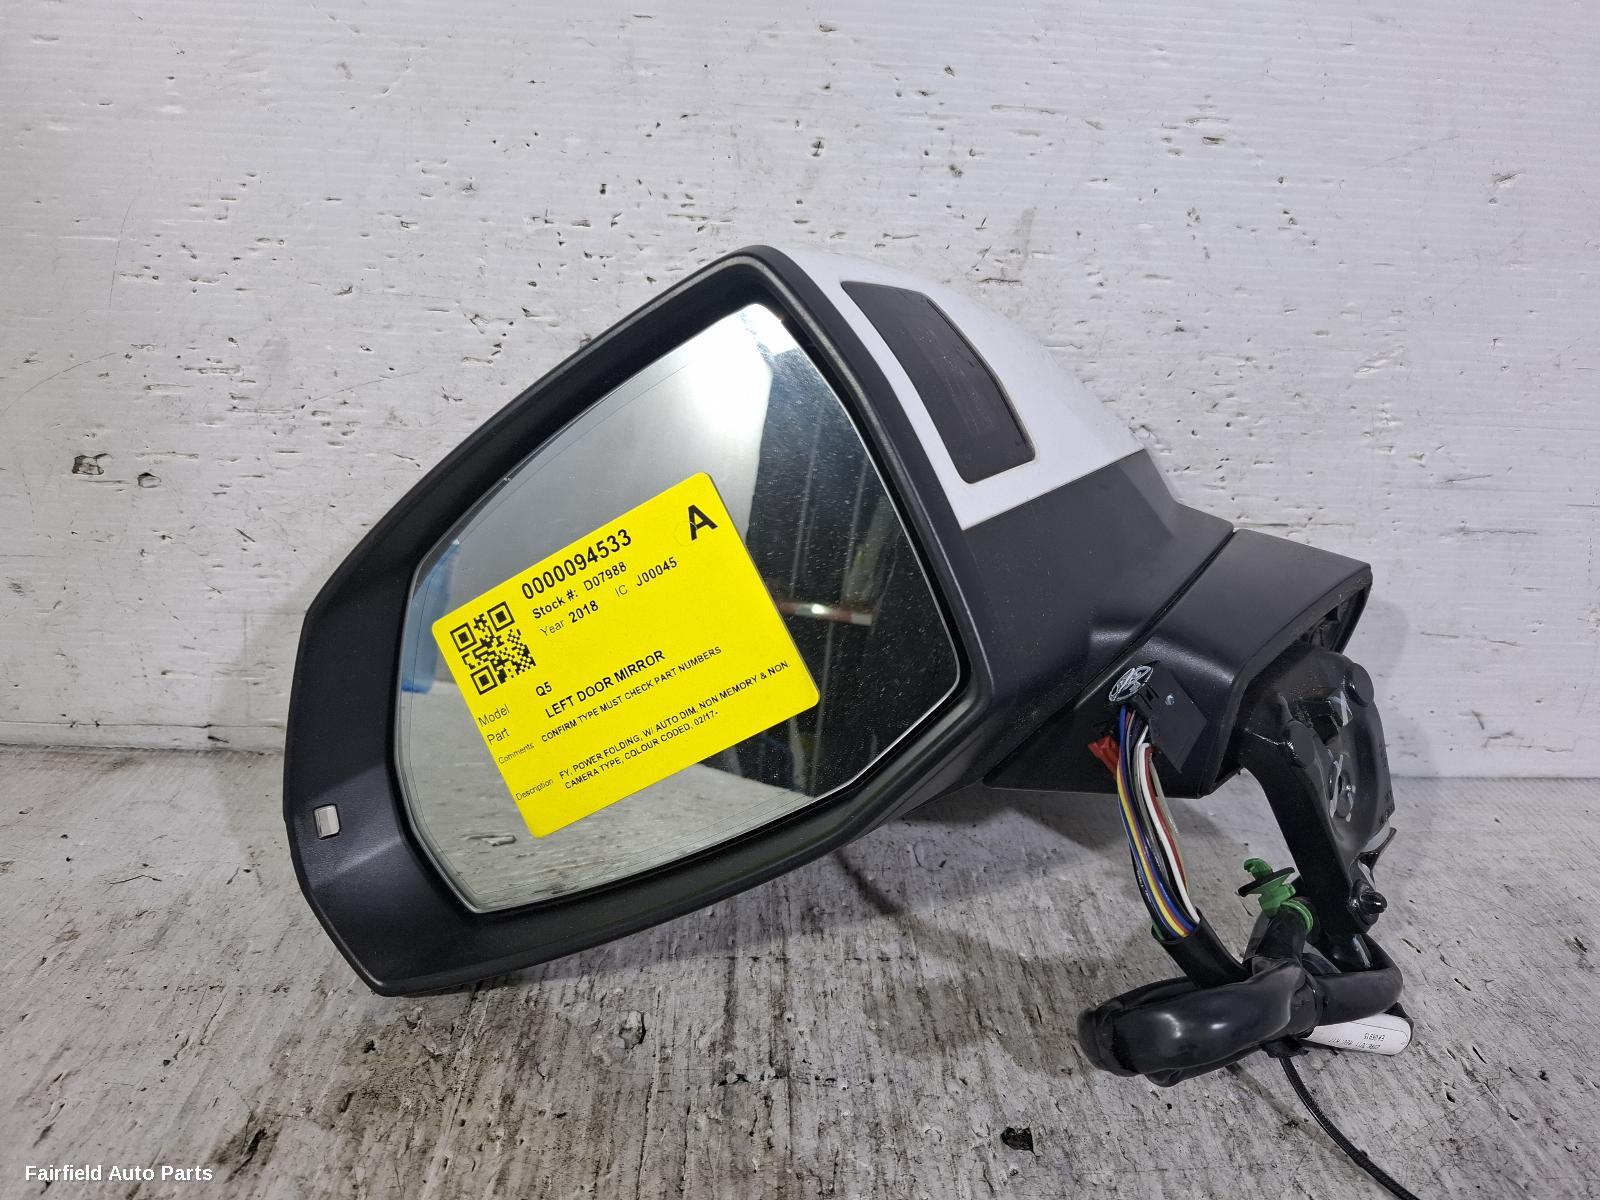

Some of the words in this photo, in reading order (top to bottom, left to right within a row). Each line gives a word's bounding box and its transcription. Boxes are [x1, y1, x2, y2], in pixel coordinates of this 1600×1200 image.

[687, 503, 719, 542] A
[521, 528, 632, 600] 0000094533
[531, 595, 566, 620] Stock
[565, 588, 579, 602] #:
[582, 561, 627, 592] D07988
[614, 584, 628, 598] IC
[636, 556, 678, 587] J00045
[539, 619, 565, 637] Year
[567, 599, 599, 624] 2018
[477, 703, 510, 728] Model
[535, 680, 553, 697] Q5
[486, 727, 510, 746] Part
[544, 694, 575, 719] LEFT
[575, 676, 615, 703] DOOR
[613, 649, 667, 683] MIRROR
[498, 742, 535, 765] Comments
[541, 718, 578, 743] CONFIRM
[576, 707, 600, 724] TYPE
[598, 695, 623, 713] MUST
[624, 679, 655, 700] CHECK
[653, 667, 677, 686] PART
[677, 646, 722, 673] NUMBERS
[515, 778, 554, 801] Description
[572, 752, 605, 773] POWER
[602, 734, 644, 758] FOLDING,
[655, 715, 680, 733] AUTO
[698, 694, 719, 710] NON
[718, 674, 758, 701] MEMORY
[759, 671, 768, 680] &
[767, 659, 789, 677] NON
[564, 768, 600, 790] CAMERA
[598, 756, 625, 772] TYPE,
[624, 738, 660, 760] COLOUR
[660, 722, 694, 743] CODED,
